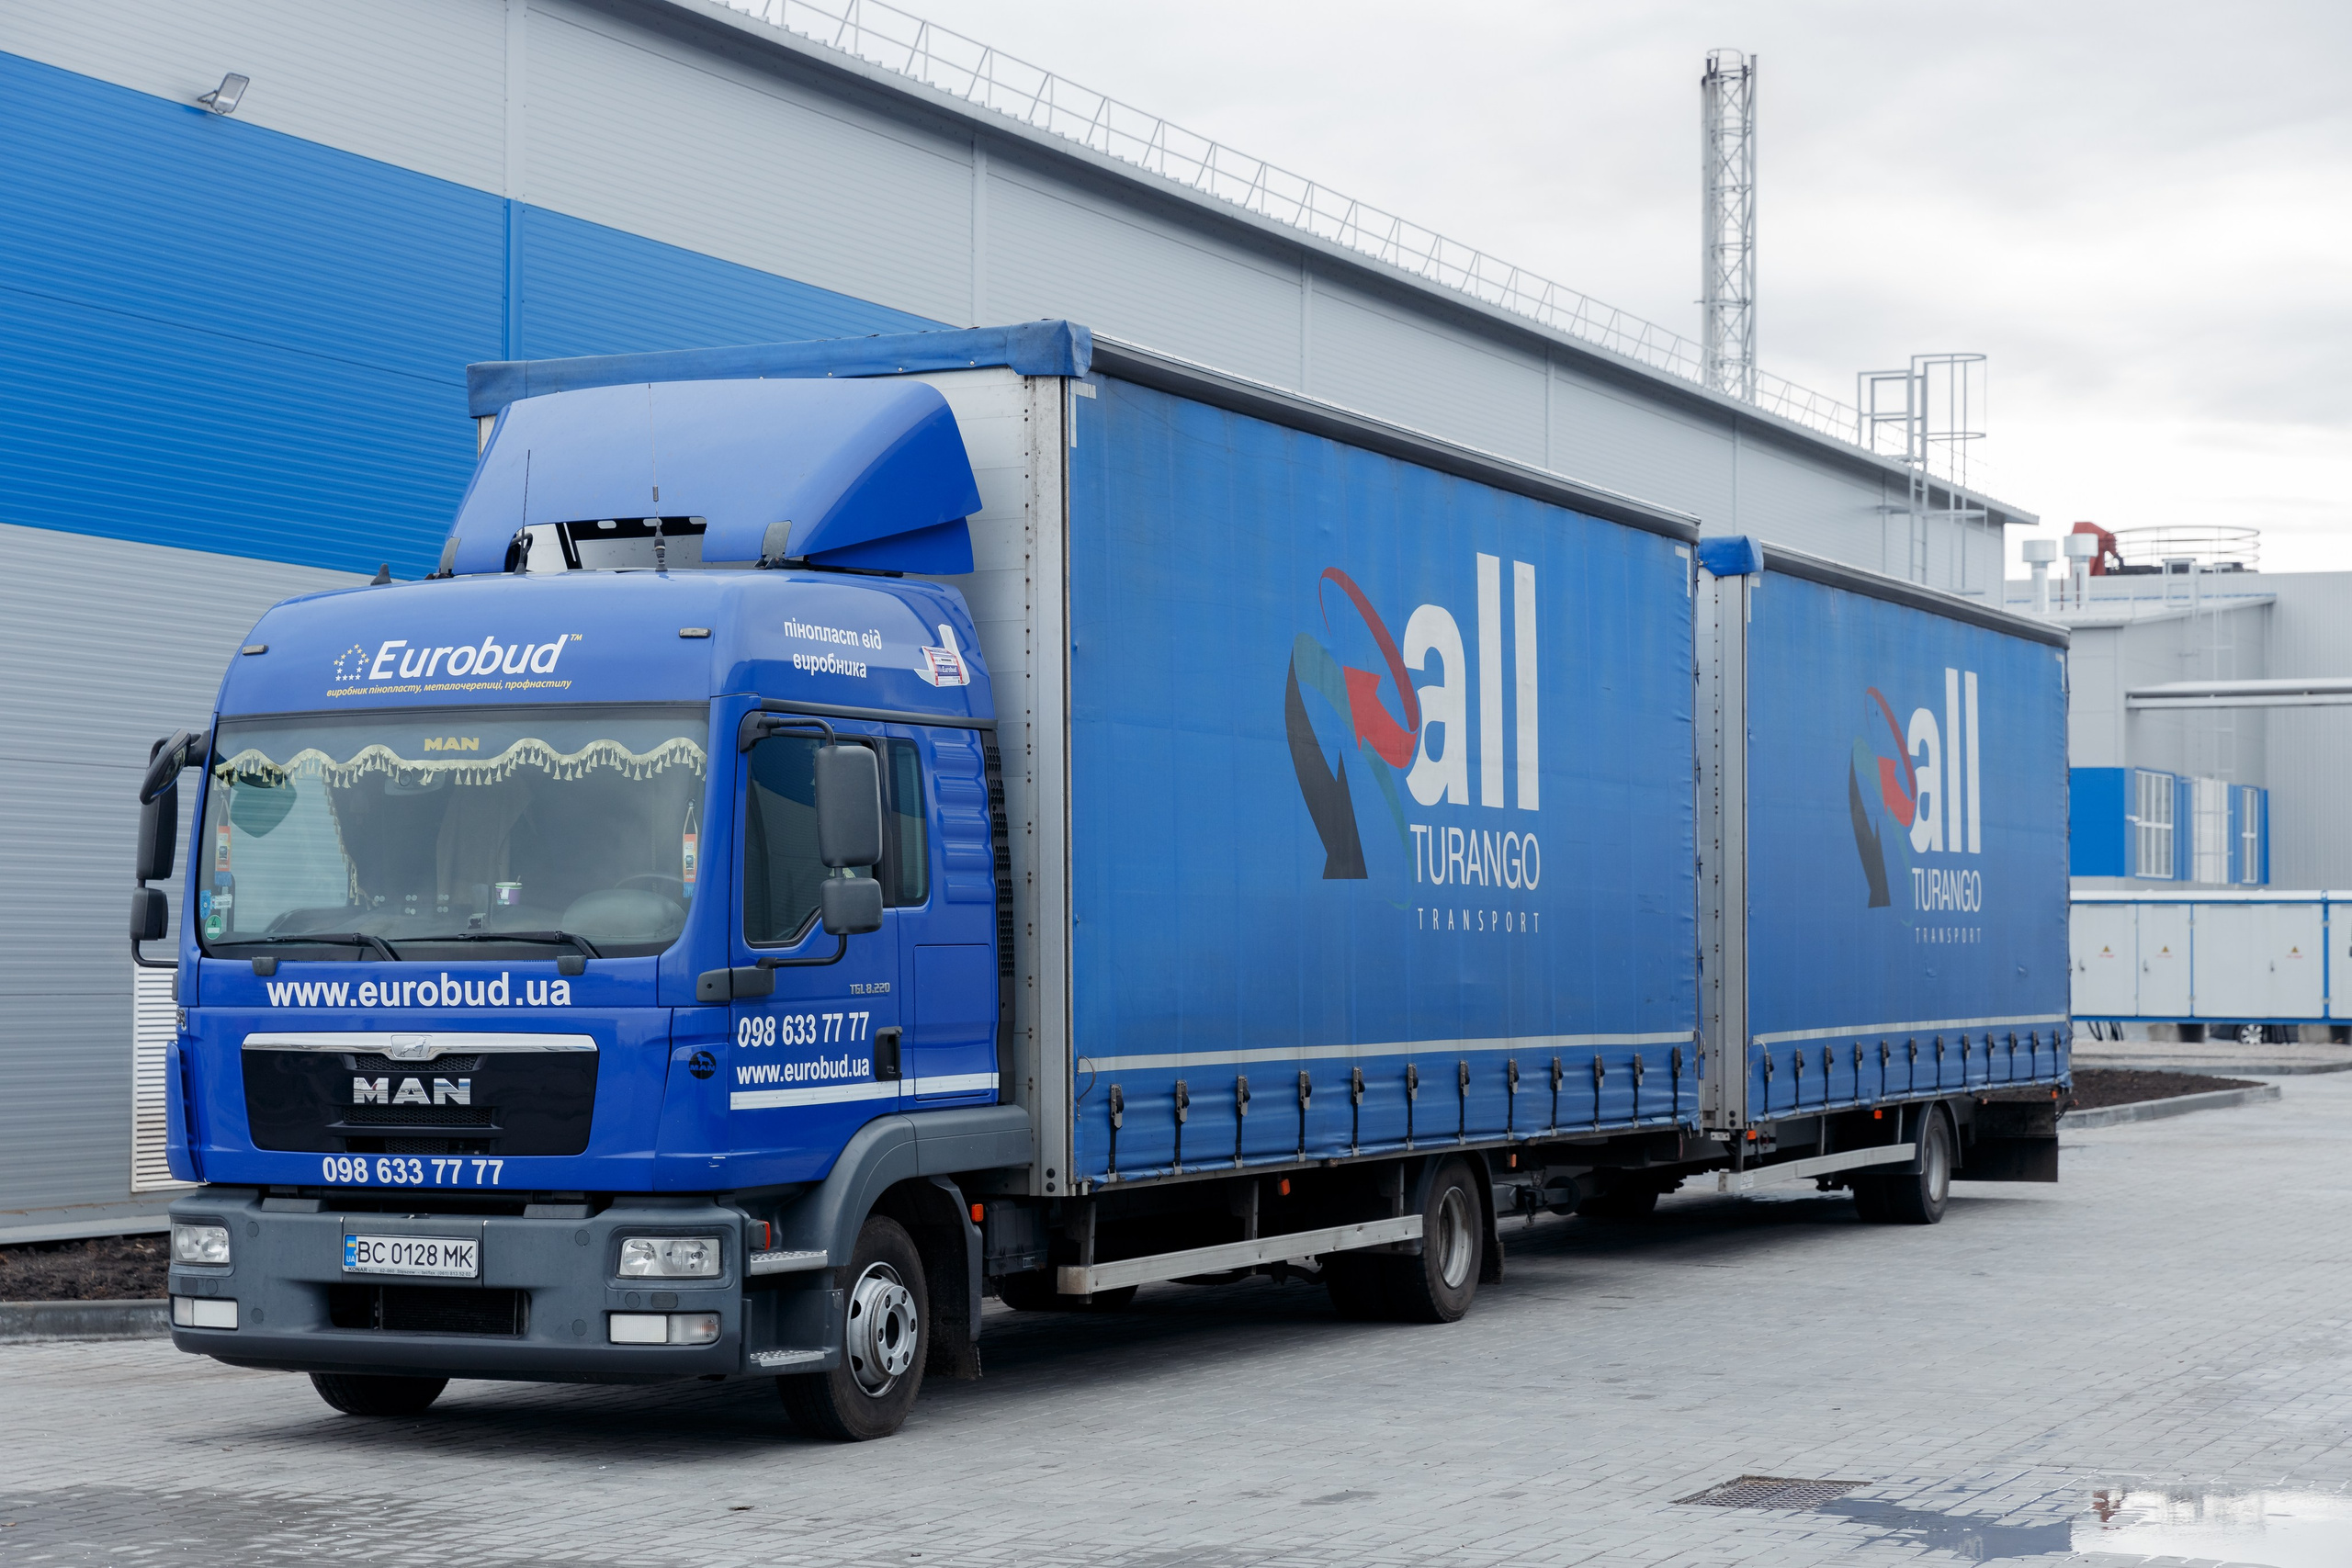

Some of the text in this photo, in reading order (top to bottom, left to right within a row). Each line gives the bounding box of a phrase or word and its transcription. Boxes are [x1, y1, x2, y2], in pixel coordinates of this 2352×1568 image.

[784, 616, 883, 650] пінопласт від
[368, 634, 569, 681] Eurobud
[792, 652, 867, 679] виробника
[326, 678, 572, 698] виробник пінопласту, металочерепиці, профнастилу
[1403, 551, 1540, 812] all
[424, 737, 480, 751] MAN
[1907, 666, 1982, 854] all
[1409, 823, 1541, 891] TURANGO
[1911, 867, 1982, 913] TURANGO
[211, 917, 217, 928] 4
[1417, 908, 1539, 933] TRANSPORT
[1915, 927, 1982, 944] TRANSPORT
[266, 971, 571, 1008] www.eurobud.ua
[849, 982, 891, 995] TGL 8.220
[737, 1011, 870, 1048] 098 633 77 77
[736, 1054, 870, 1085] www.eurobud.ua
[353, 1077, 471, 1105] MAN
[322, 1156, 504, 1185] 098 633 77 77
[345, 1255, 356, 1263] UA
[357, 1241, 474, 1269] BC 0128 MK
